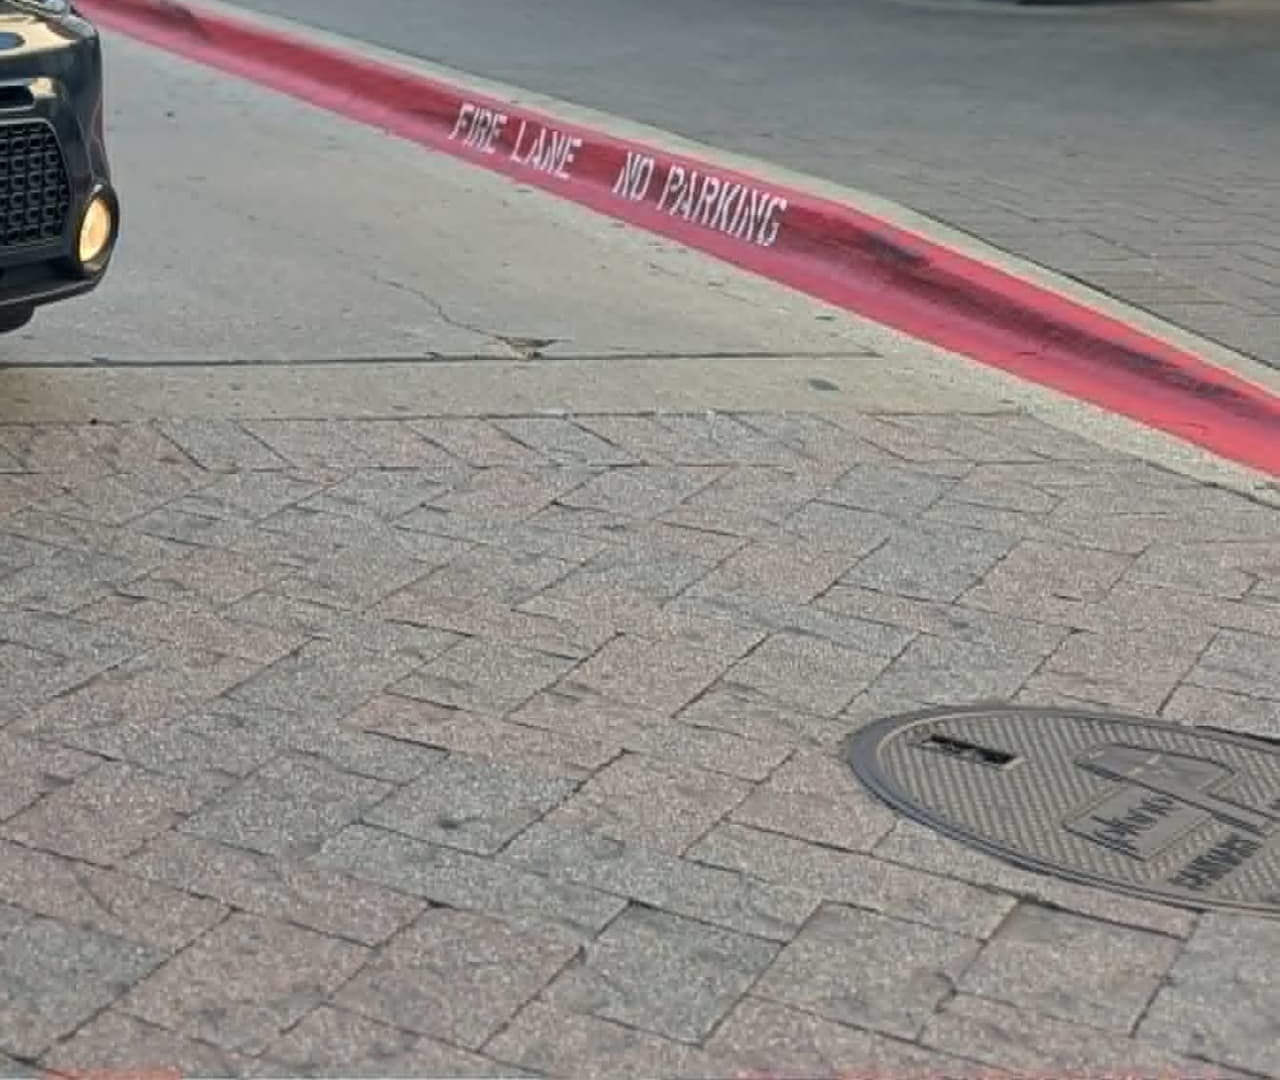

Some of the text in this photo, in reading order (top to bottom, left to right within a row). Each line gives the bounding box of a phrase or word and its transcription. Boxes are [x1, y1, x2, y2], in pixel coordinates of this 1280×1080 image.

[448, 102, 788, 247] FIRE LANE NO PARKING
